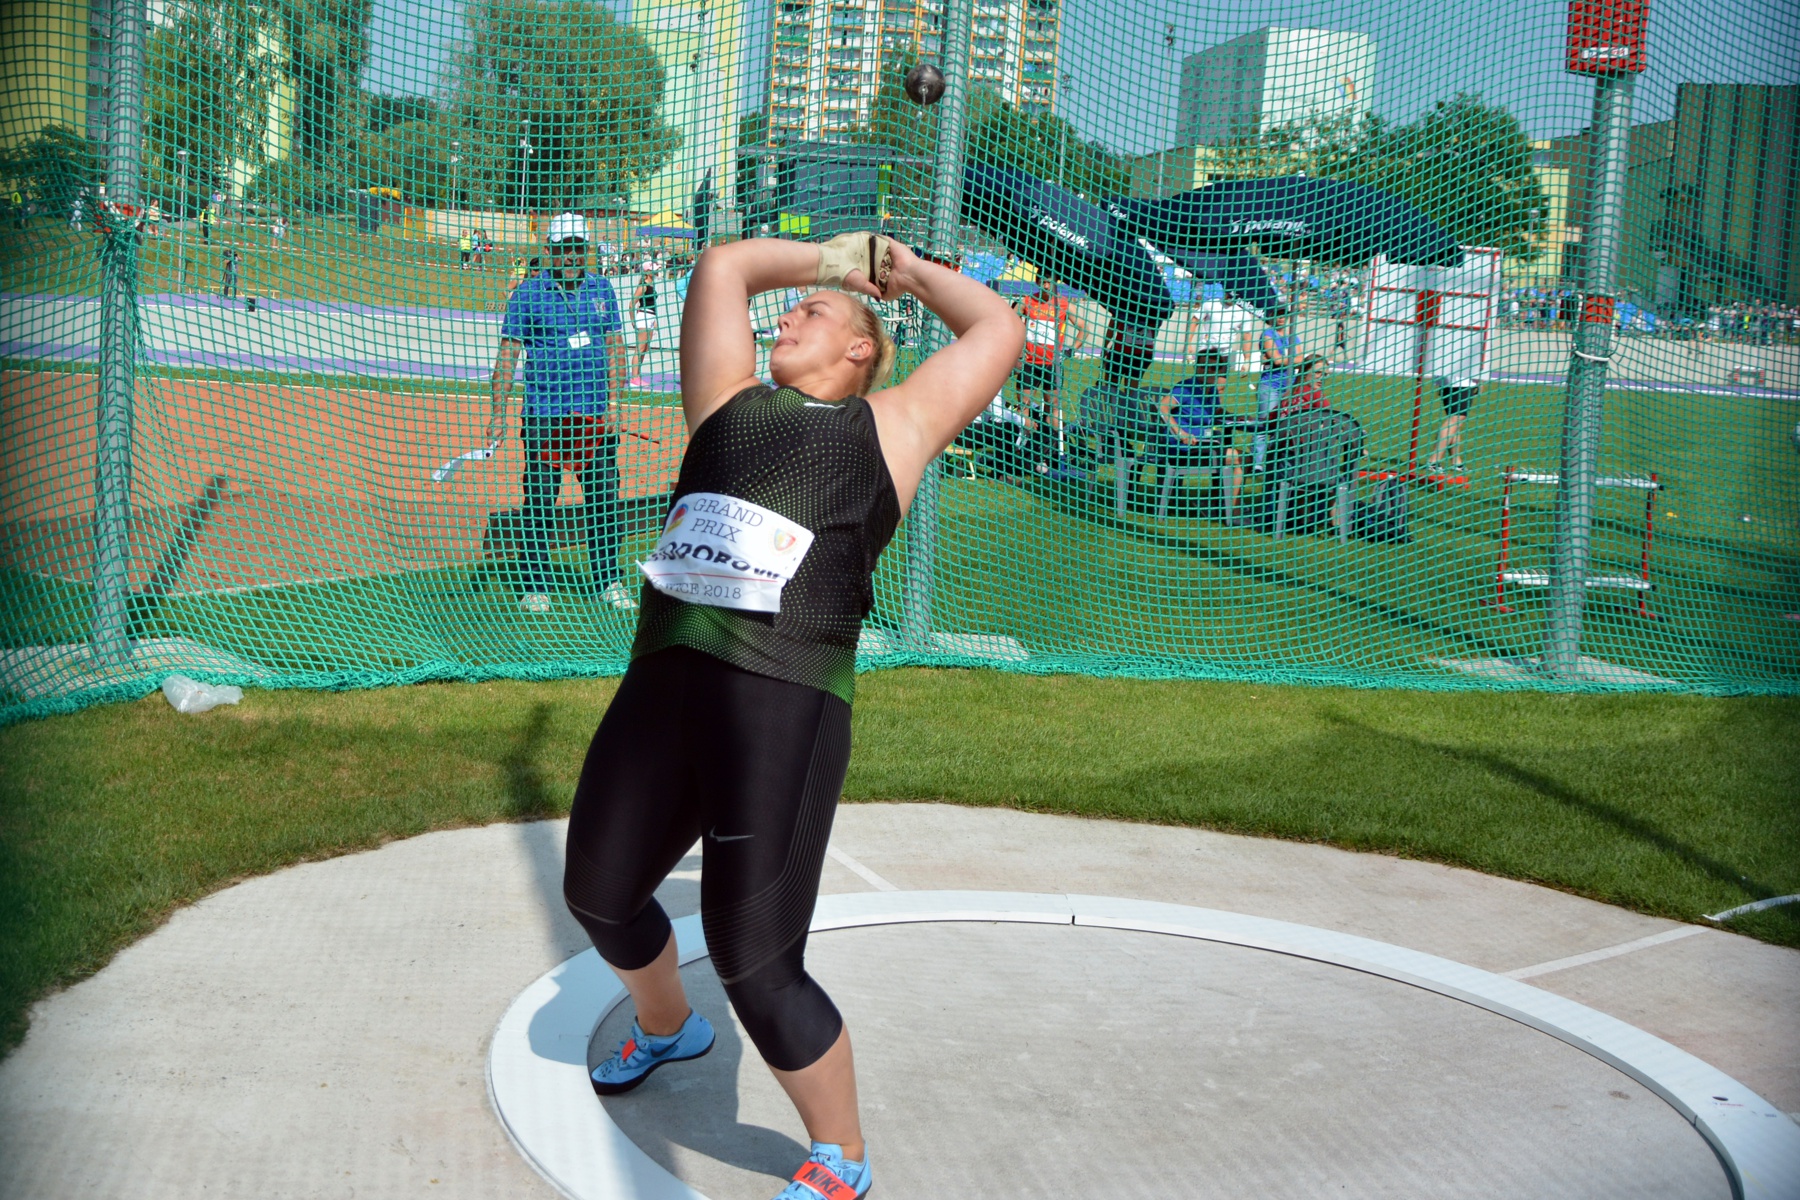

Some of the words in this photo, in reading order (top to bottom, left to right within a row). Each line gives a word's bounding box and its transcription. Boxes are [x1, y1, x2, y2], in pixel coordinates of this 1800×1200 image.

[693, 498, 763, 527] GRAND
[690, 518, 742, 543] PRIX
[703, 584, 742, 600] 2018
[803, 1166, 844, 1197] NIKE
